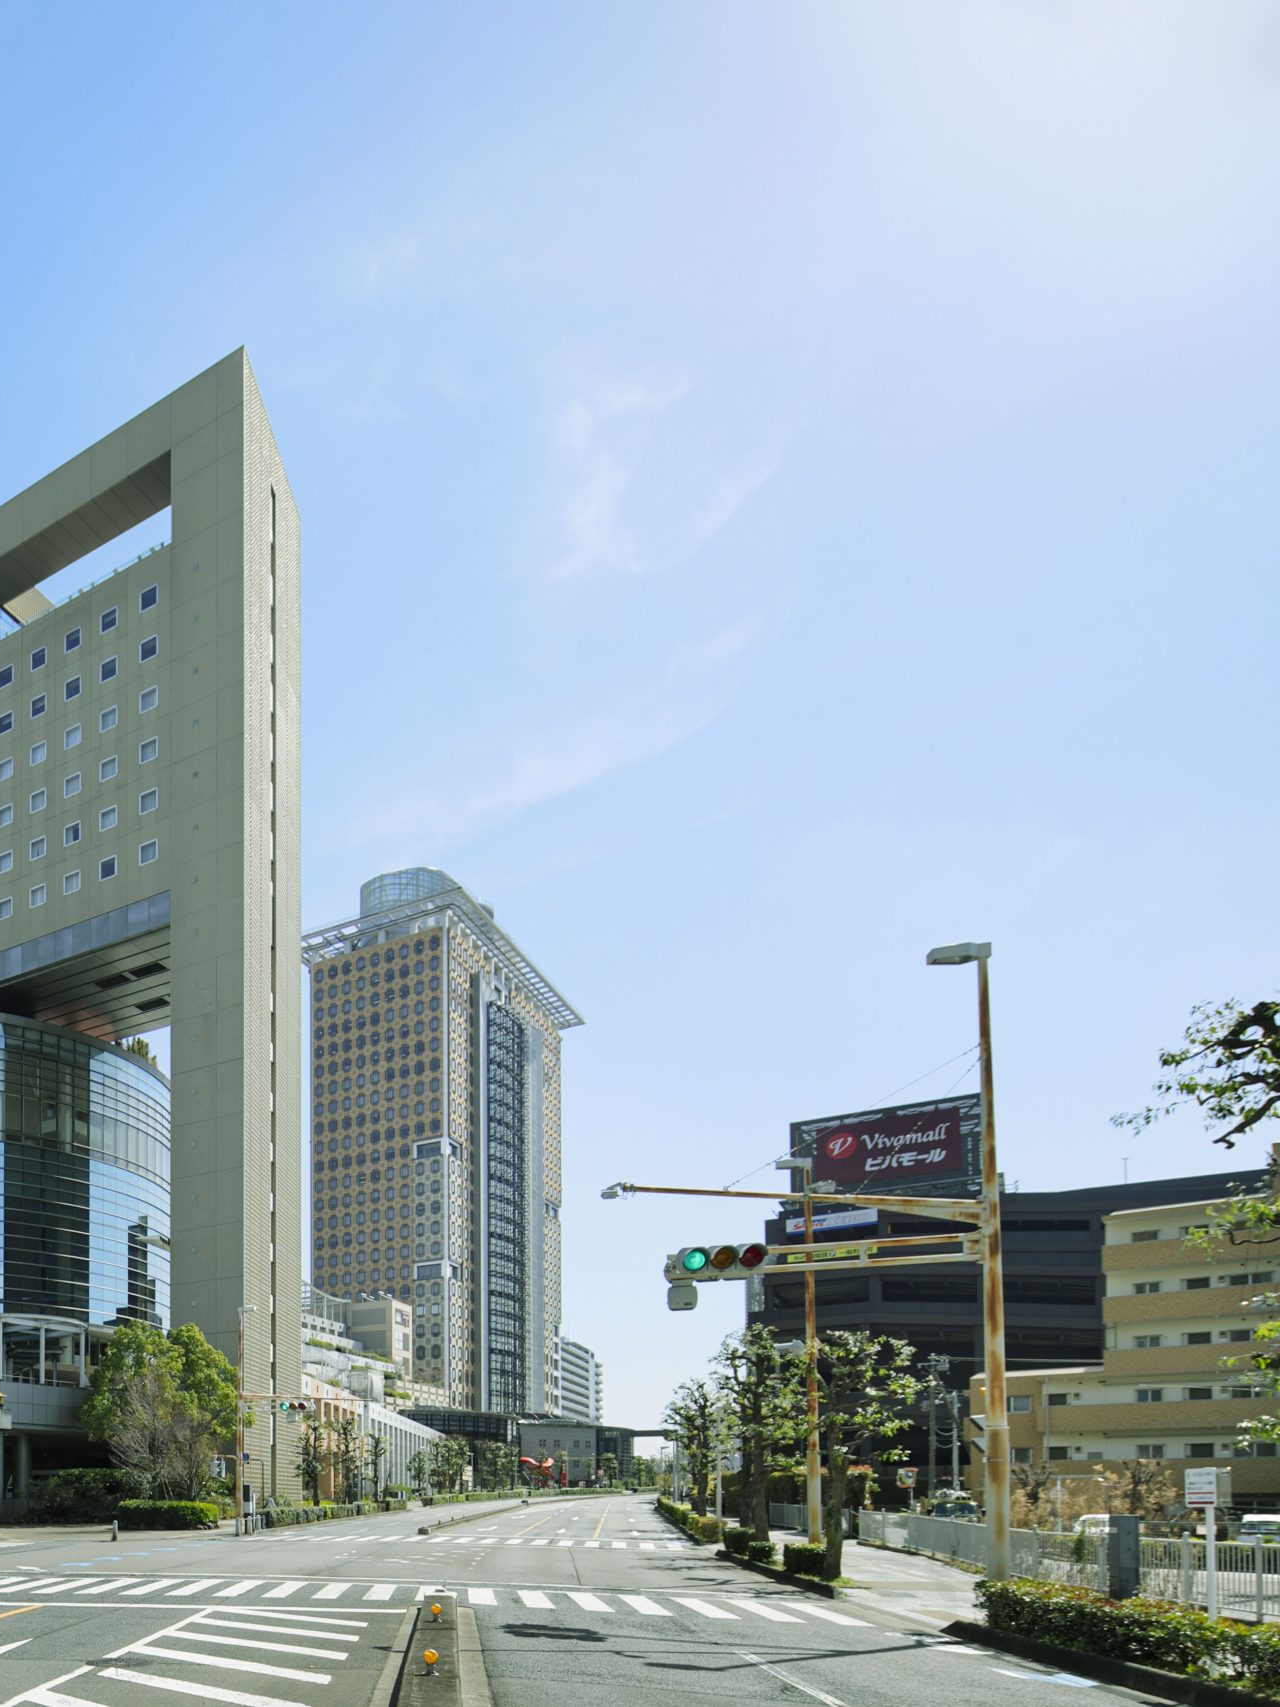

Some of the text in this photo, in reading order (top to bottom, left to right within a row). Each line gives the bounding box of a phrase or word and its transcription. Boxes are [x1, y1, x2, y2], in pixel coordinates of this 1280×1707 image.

[860, 1122, 951, 1150] Vivamall
[864, 1148, 947, 1172] ビバモール
